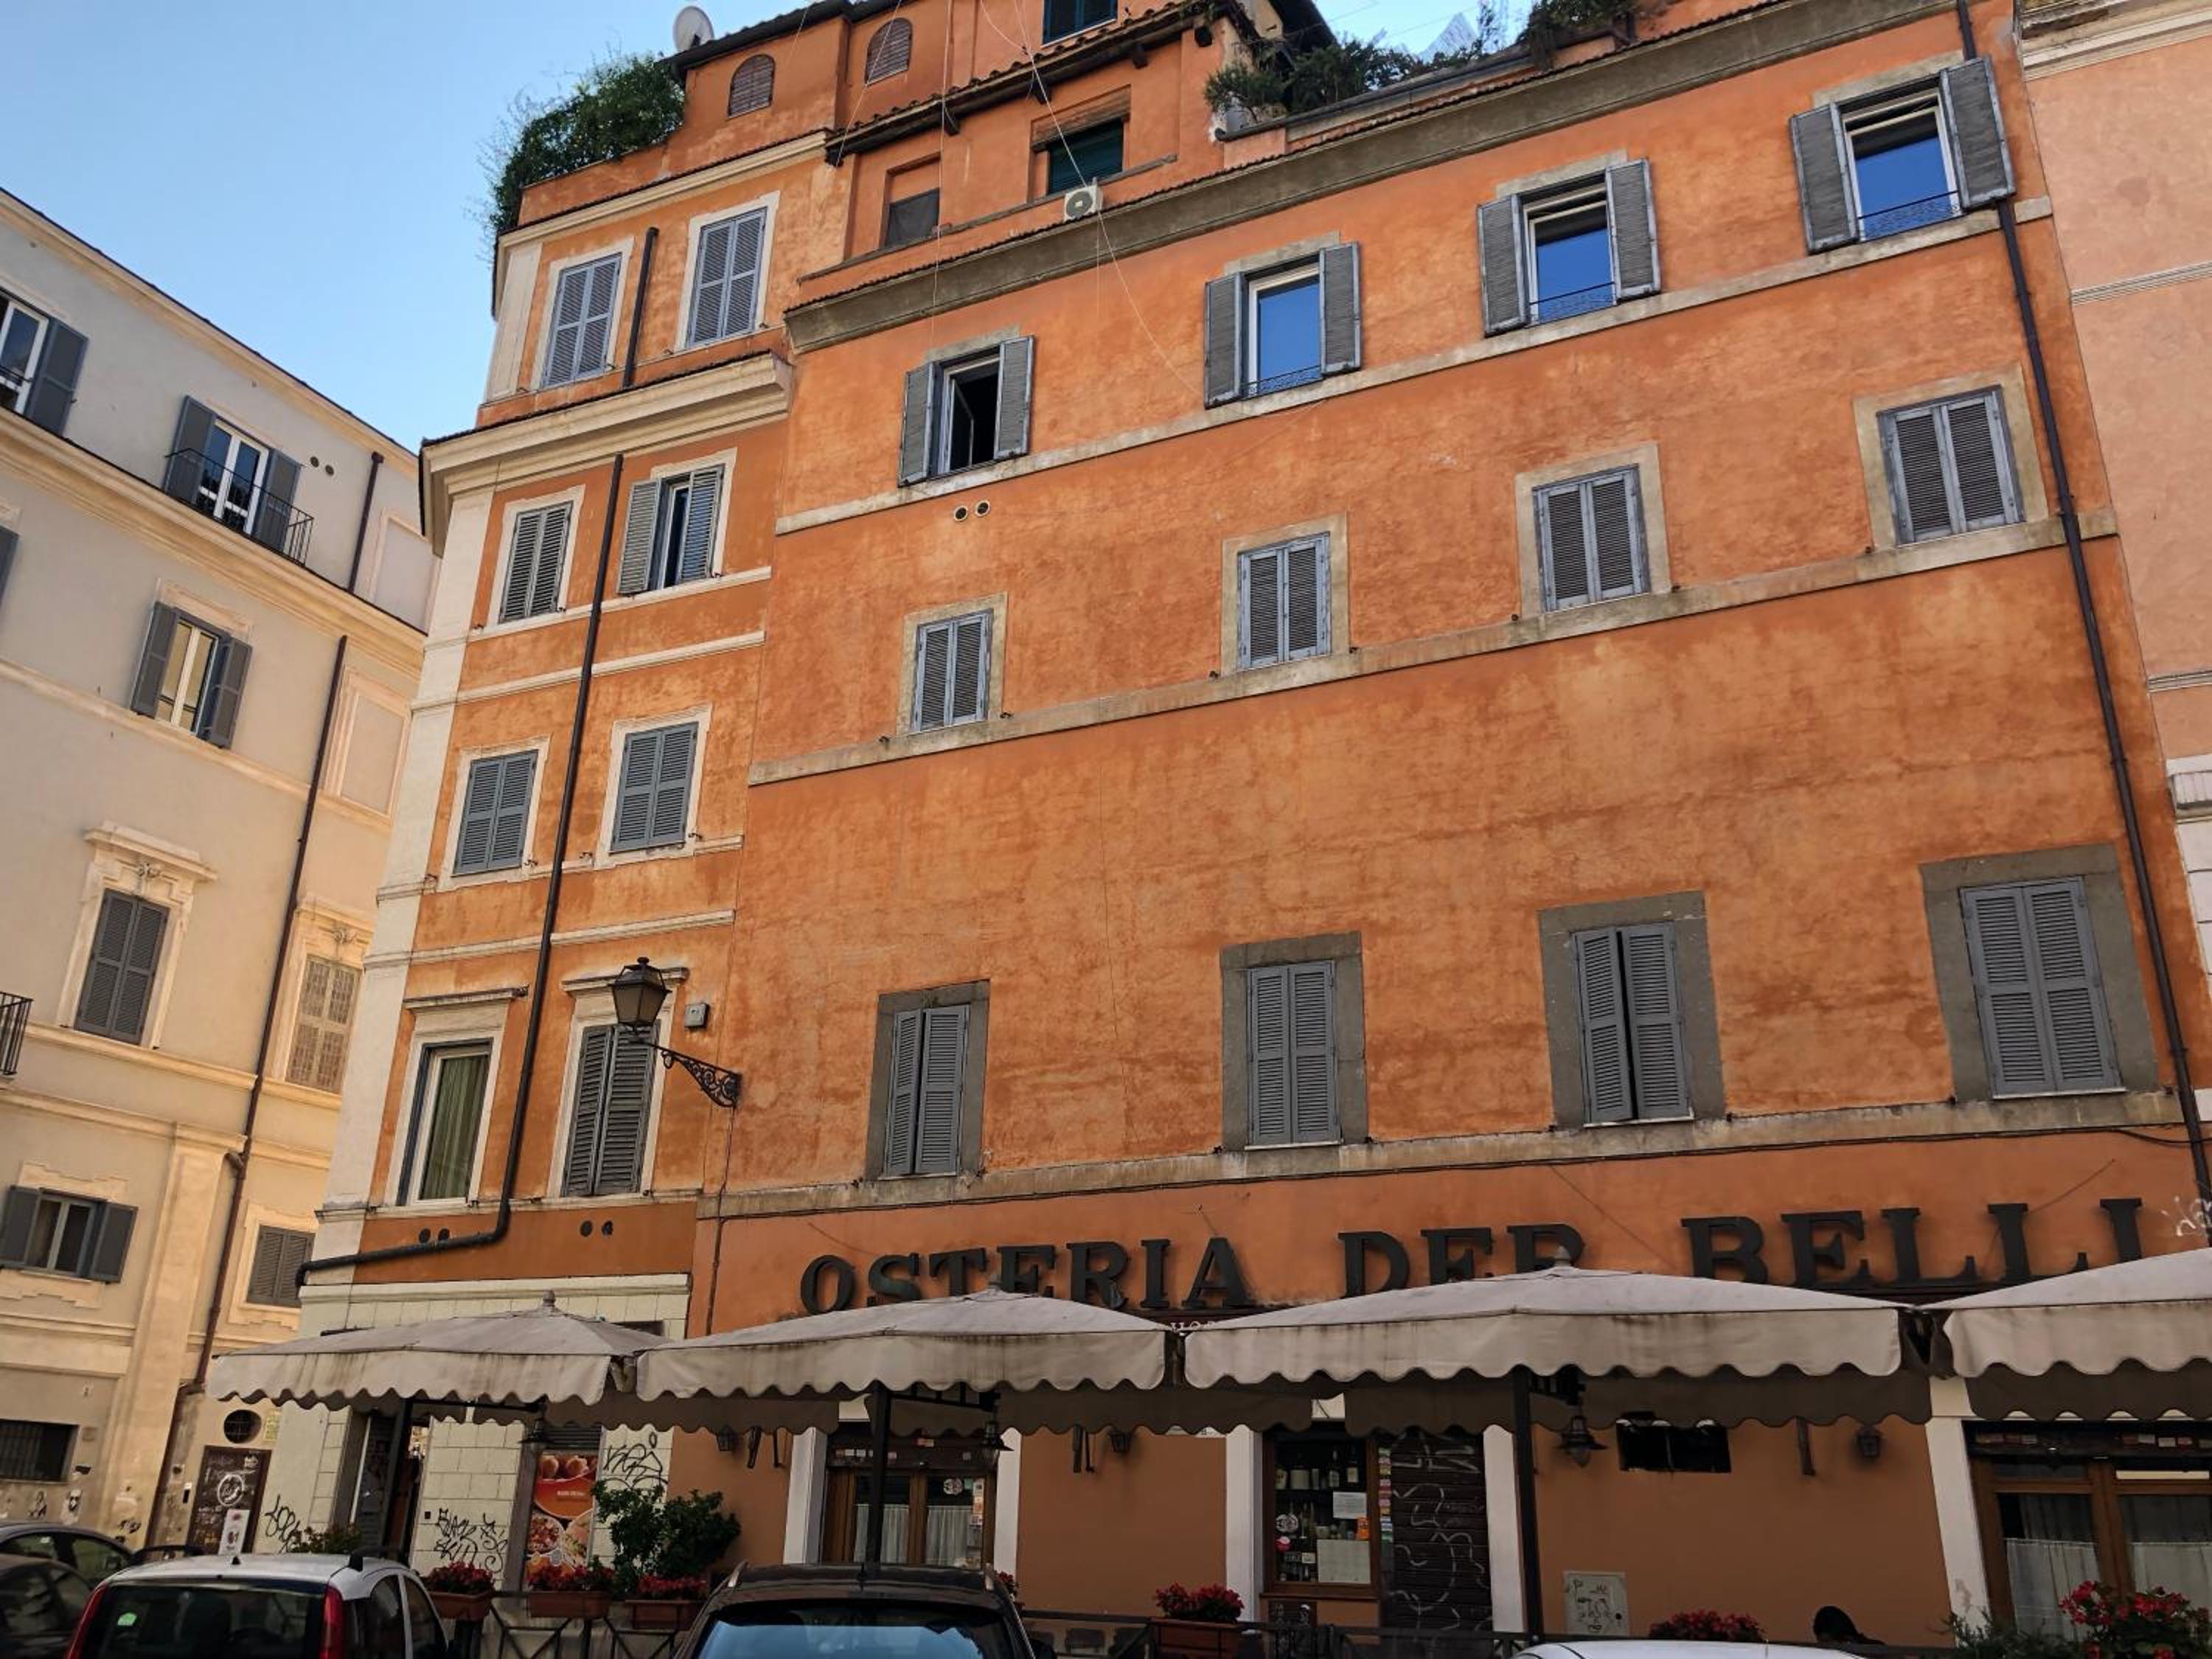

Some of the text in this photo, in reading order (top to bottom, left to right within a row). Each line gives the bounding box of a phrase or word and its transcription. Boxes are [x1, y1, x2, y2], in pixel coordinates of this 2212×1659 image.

[800, 1237, 1255, 1315] OSTERIA
[1338, 1224, 1585, 1299] DER
[1681, 1198, 2142, 1287] BELLI
